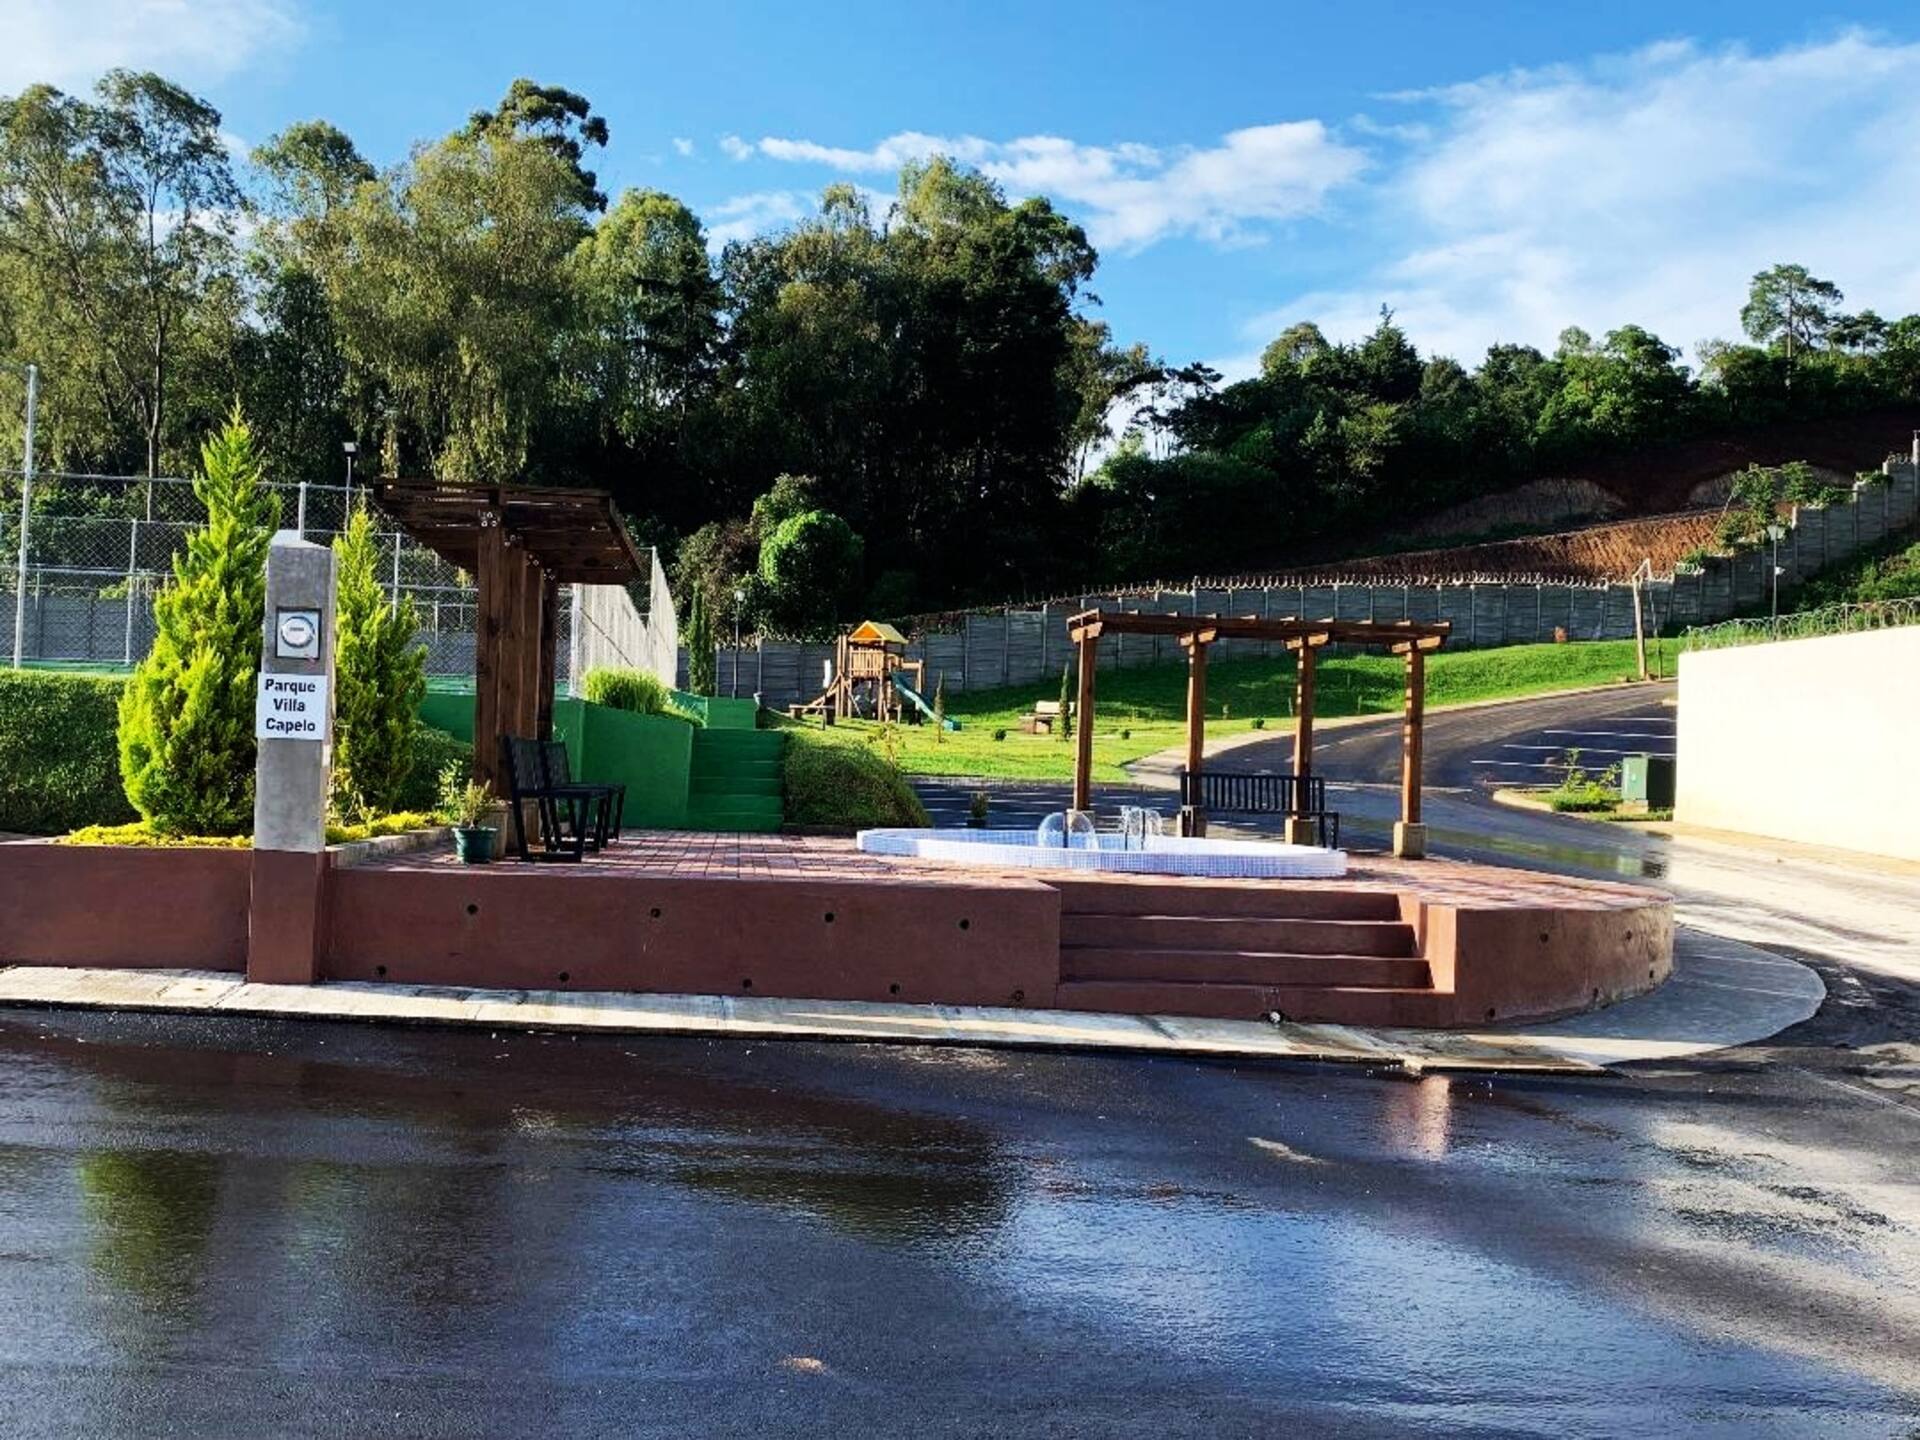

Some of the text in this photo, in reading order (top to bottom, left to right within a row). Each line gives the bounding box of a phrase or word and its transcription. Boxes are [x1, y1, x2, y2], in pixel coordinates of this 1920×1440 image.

[265, 678, 316, 695] Parque
[273, 698, 305, 712] Villa
[266, 717, 316, 734] Capelo
